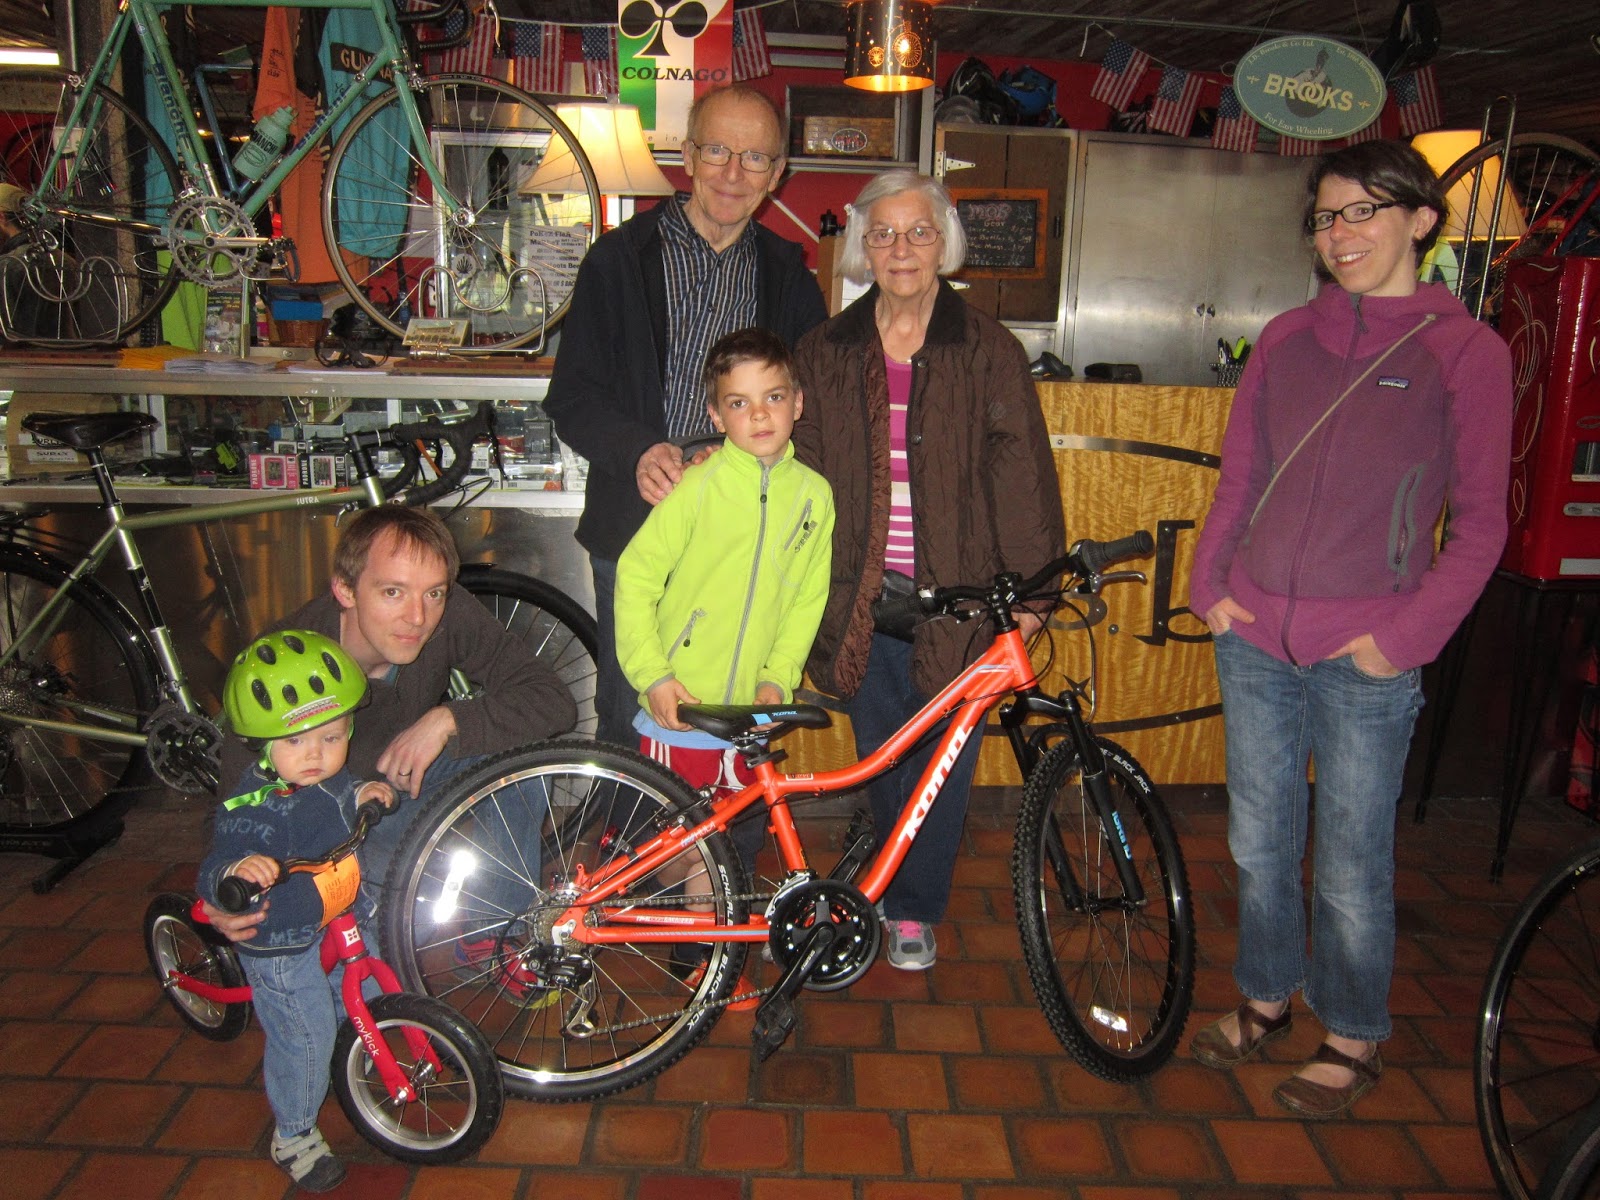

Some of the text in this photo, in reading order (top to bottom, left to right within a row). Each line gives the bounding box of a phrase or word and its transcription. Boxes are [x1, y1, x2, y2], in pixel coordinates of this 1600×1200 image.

[621, 65, 727, 82] COLNAGO
[1263, 73, 1353, 112] BROOKS
[1264, 111, 1333, 135] For Easy Wheeling
[296, 496, 320, 505] SUTRA
[896, 725, 974, 842] KONA
[1112, 753, 1152, 795] BLACK JACK
[708, 951, 729, 996] BLACK
[353, 1016, 380, 1057] mykick
